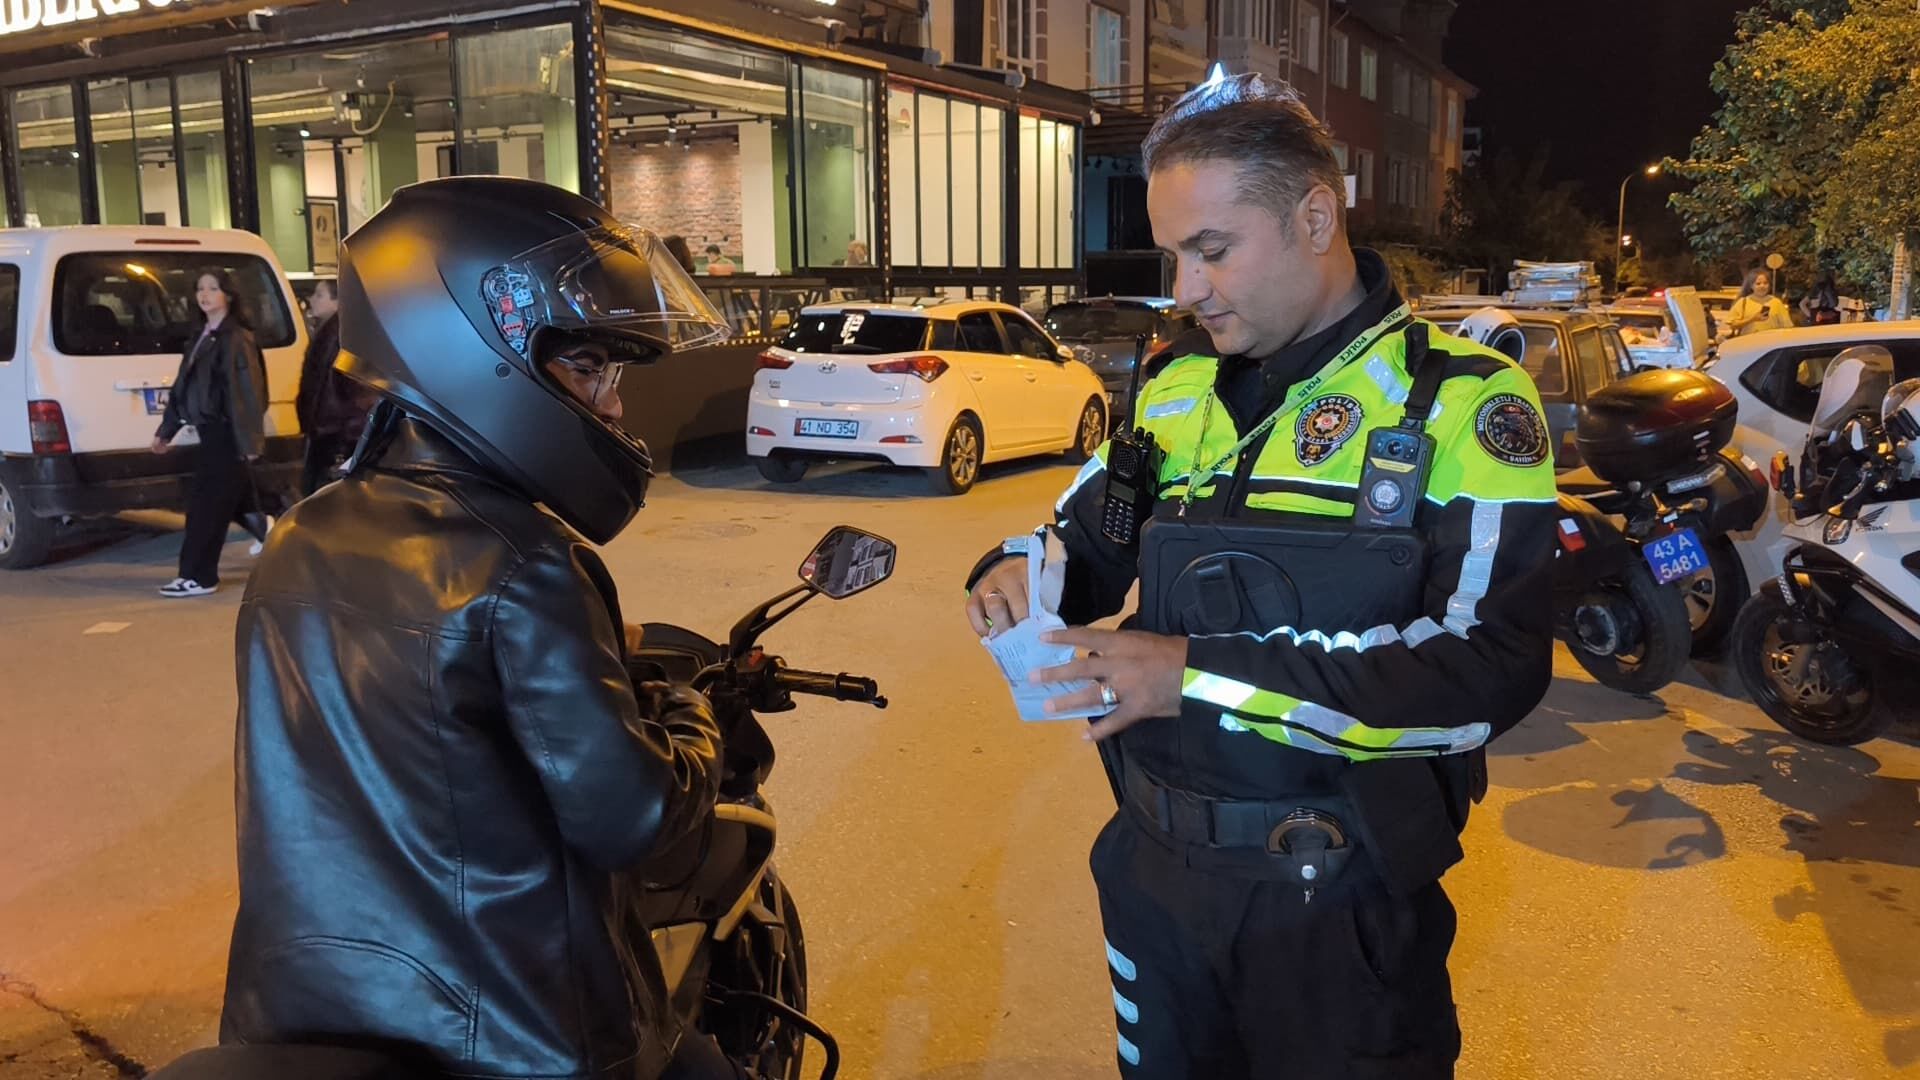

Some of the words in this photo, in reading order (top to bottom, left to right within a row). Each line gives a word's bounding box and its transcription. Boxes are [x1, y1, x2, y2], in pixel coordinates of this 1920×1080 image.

[1654, 540, 1675, 559] 43
[1678, 534, 1693, 551] A
[1660, 551, 1701, 579] 5481
